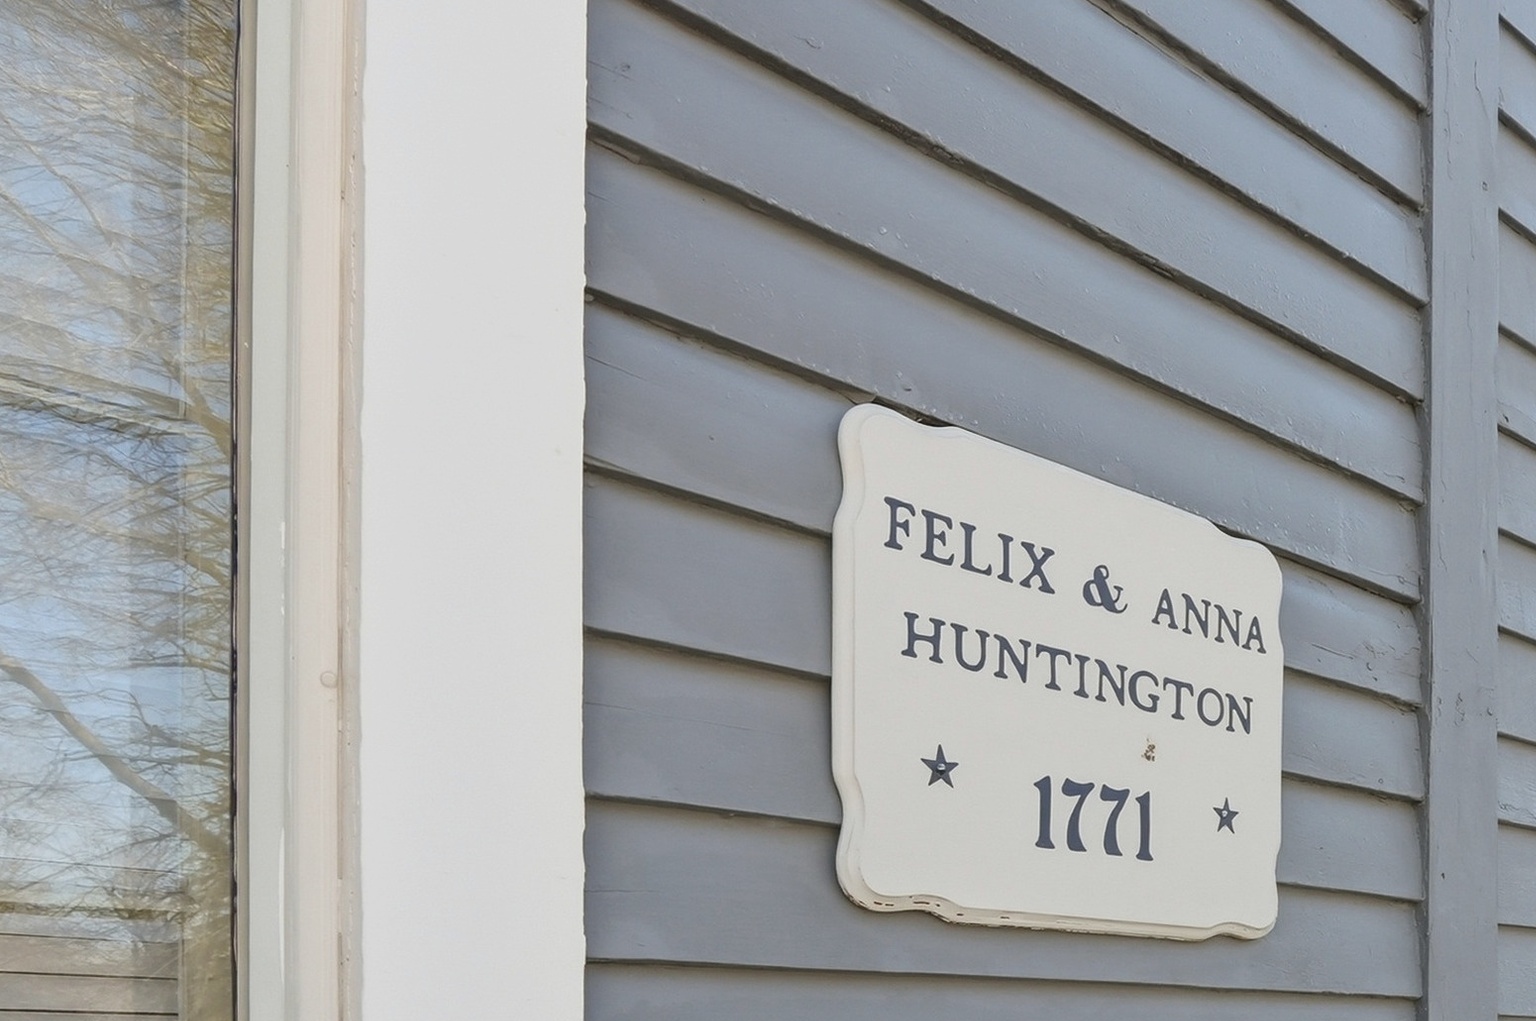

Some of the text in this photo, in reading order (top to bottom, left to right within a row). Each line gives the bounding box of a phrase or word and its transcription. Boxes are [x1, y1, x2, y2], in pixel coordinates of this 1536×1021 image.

[883, 496, 1267, 655] FELIX & ANNA
[900, 611, 1254, 735] HUNTINGTON
[1032, 775, 1154, 862] 1771
